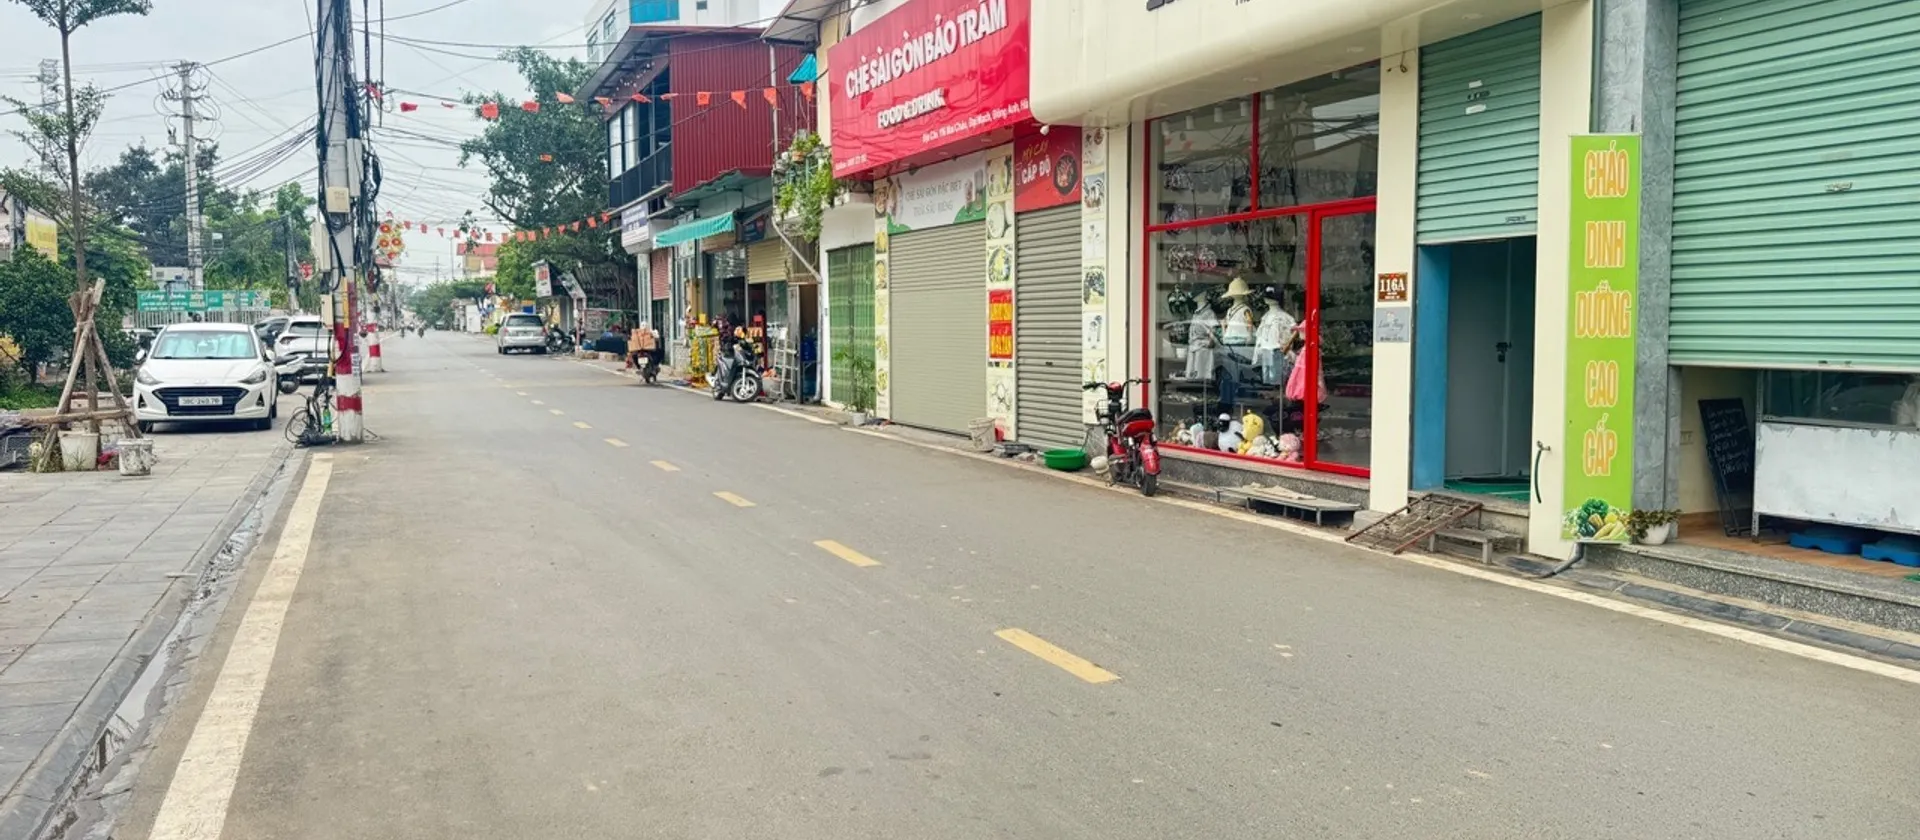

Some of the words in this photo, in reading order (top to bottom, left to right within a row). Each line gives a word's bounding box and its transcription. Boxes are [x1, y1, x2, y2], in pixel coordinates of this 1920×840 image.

[846, 55, 870, 98] CHÈ
[869, 46, 893, 89] SÀI
[891, 31, 925, 78] GÒN
[923, 14, 958, 62] BẢO
[1584, 140, 1629, 199] CHÁO
[1585, 221, 1626, 268] DINH
[1380, 278, 1405, 293] 116A
[1575, 280, 1632, 338] DƯỠNG
[1585, 360, 1618, 408] CAO
[1583, 413, 1618, 477] CẤP
